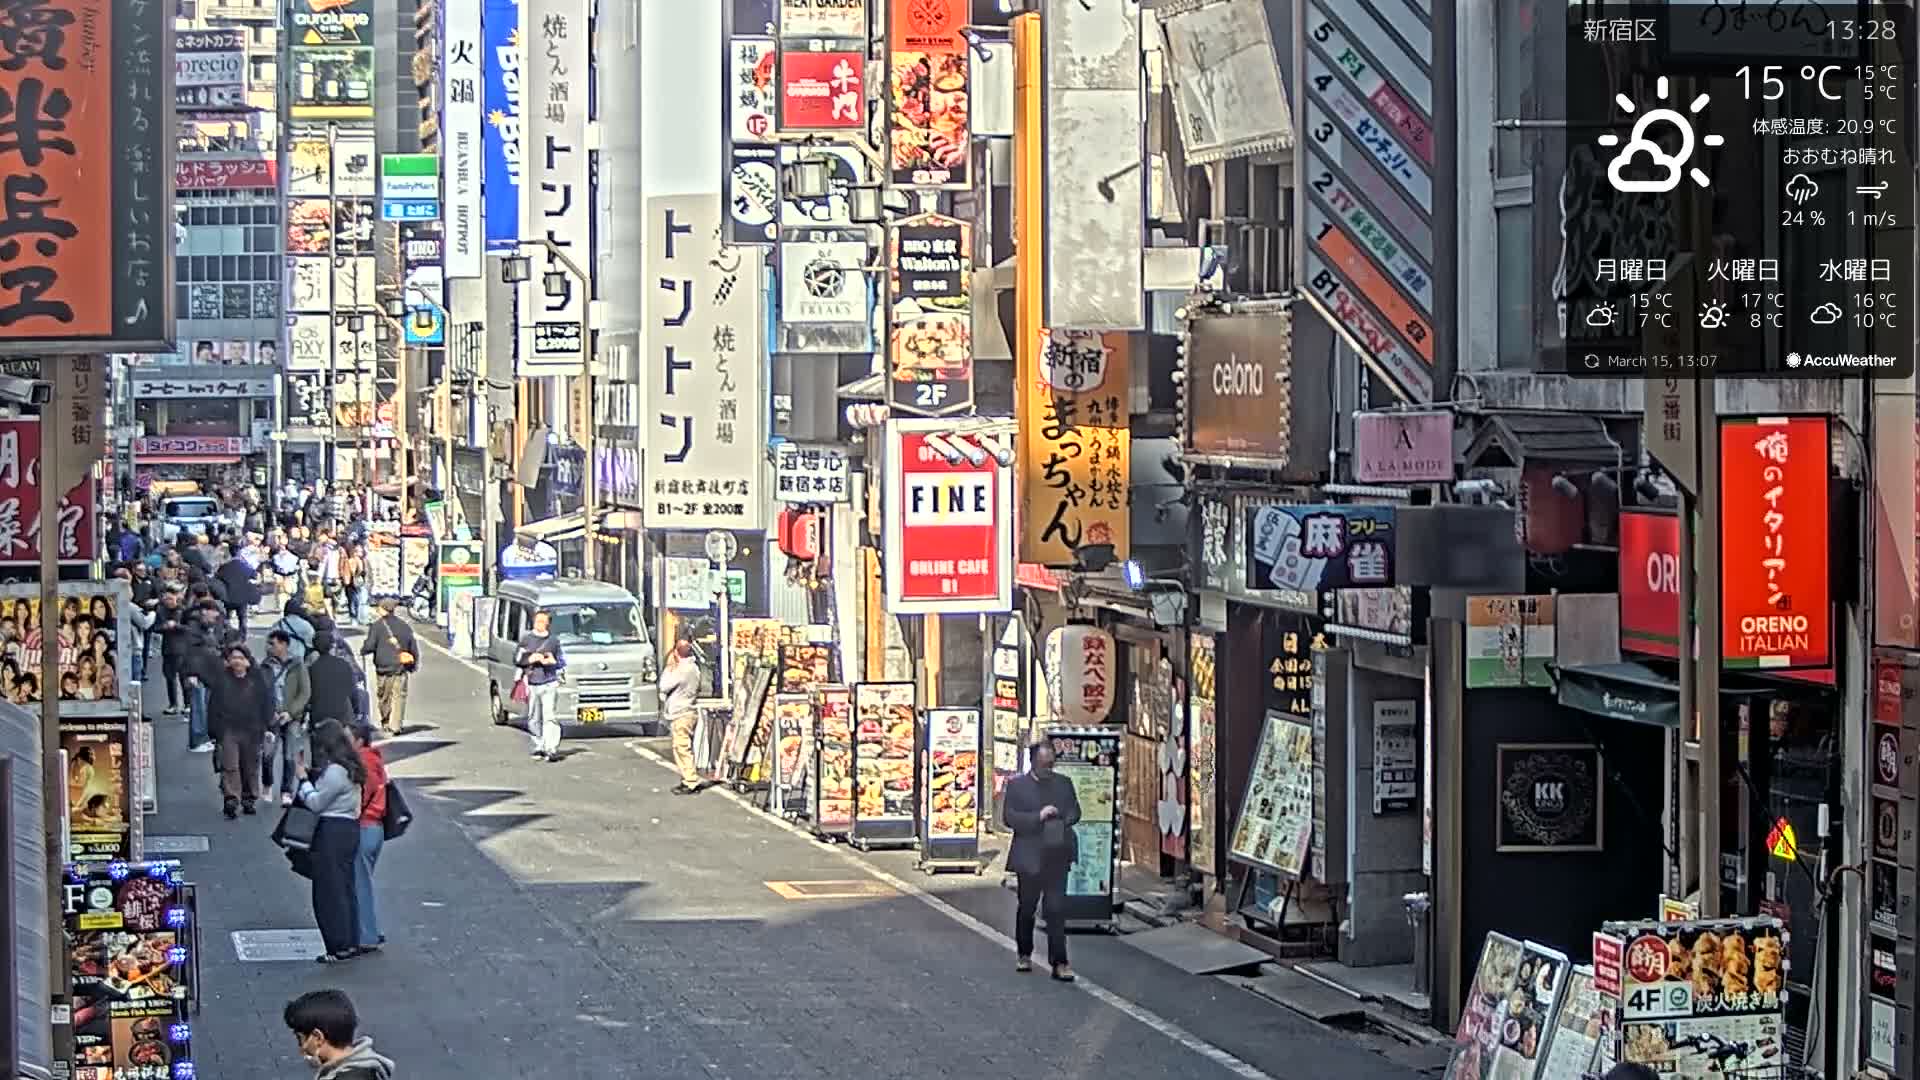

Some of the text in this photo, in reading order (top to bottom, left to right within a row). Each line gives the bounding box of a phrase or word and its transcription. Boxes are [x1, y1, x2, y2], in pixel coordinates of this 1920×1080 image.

[1315, 22, 1334, 42] 5
[450, 40, 474, 103] 火鍋
[543, 14, 569, 123] 焼とん酒場
[1314, 75, 1333, 91] 4
[1315, 123, 1333, 142] 3
[1357, 119, 1412, 179] センチュリー
[387, 181, 435, 192] FamilyMart
[1312, 172, 1333, 193] 2
[541, 135, 572, 311] トントン
[1317, 222, 1333, 240] 1
[1312, 269, 1339, 298] B1
[660, 209, 694, 463] トントン
[1044, 341, 1104, 374] 新宿
[712, 325, 738, 444] 焼とん酒場
[1213, 352, 1263, 396] celona
[916, 384, 947, 405] 2F
[780, 475, 843, 492] 新宿本店
[1041, 397, 1086, 552] まっちゃん
[654, 479, 749, 496] 新宿歌舞伎町店
[912, 485, 985, 513] FINE
[1350, 520, 1389, 535] フリー
[1755, 431, 1789, 605] 俺のイタリアン
[910, 559, 988, 575] ONLINE CAFE
[1741, 616, 1808, 633] ORENO
[1741, 635, 1808, 652] ITALIAN
[1535, 782, 1563, 800] KK
[1627, 988, 1661, 1011] 4F
[1696, 991, 1779, 1013] 炭火焼き鳥
